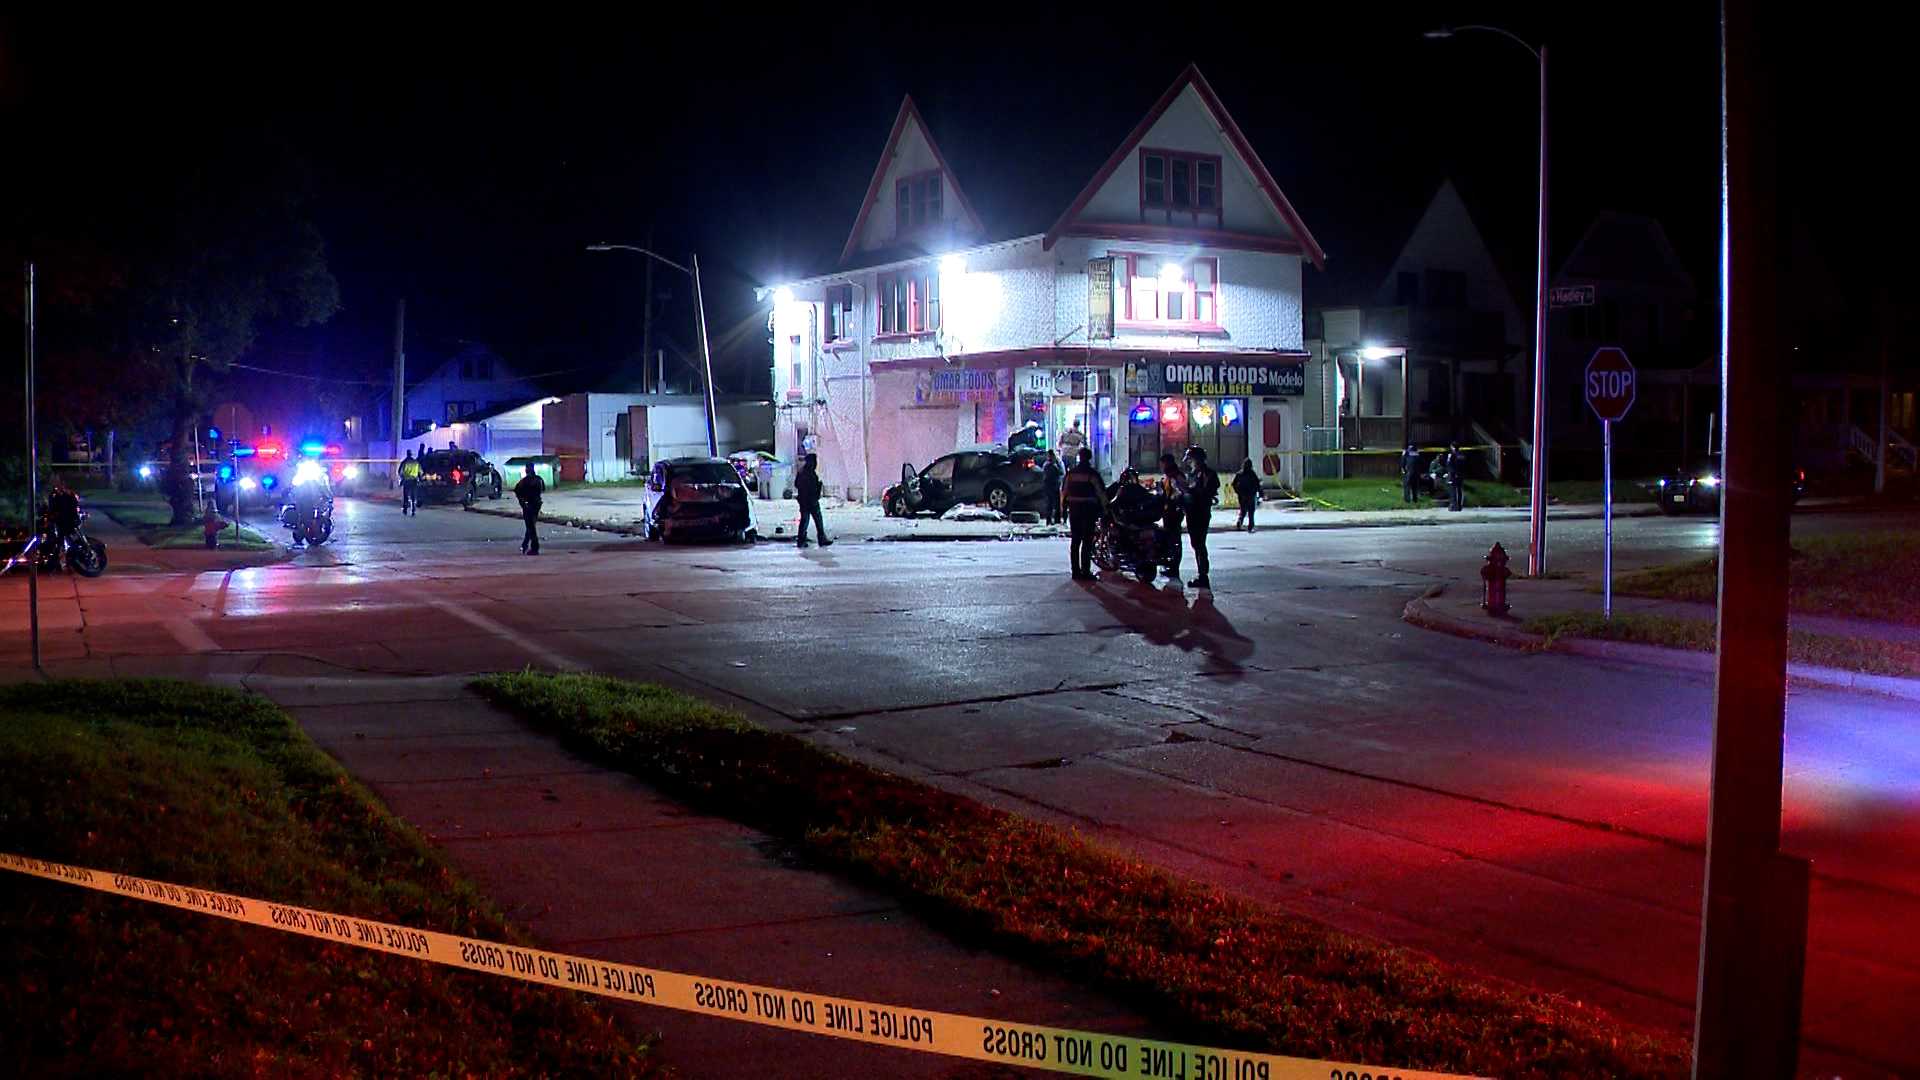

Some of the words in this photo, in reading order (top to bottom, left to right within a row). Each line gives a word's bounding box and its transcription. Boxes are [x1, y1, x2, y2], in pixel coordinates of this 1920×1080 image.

[933, 371, 960, 390] OMAR
[966, 369, 995, 389] FOODS
[1166, 364, 1211, 383] OMAR
[1219, 364, 1268, 384] FOODS
[1269, 371, 1303, 386] Modelo
[1183, 384, 1199, 395] ICE
[1202, 384, 1226, 395] COLD
[1229, 384, 1252, 395] BEER
[1590, 371, 1631, 398] STOP
